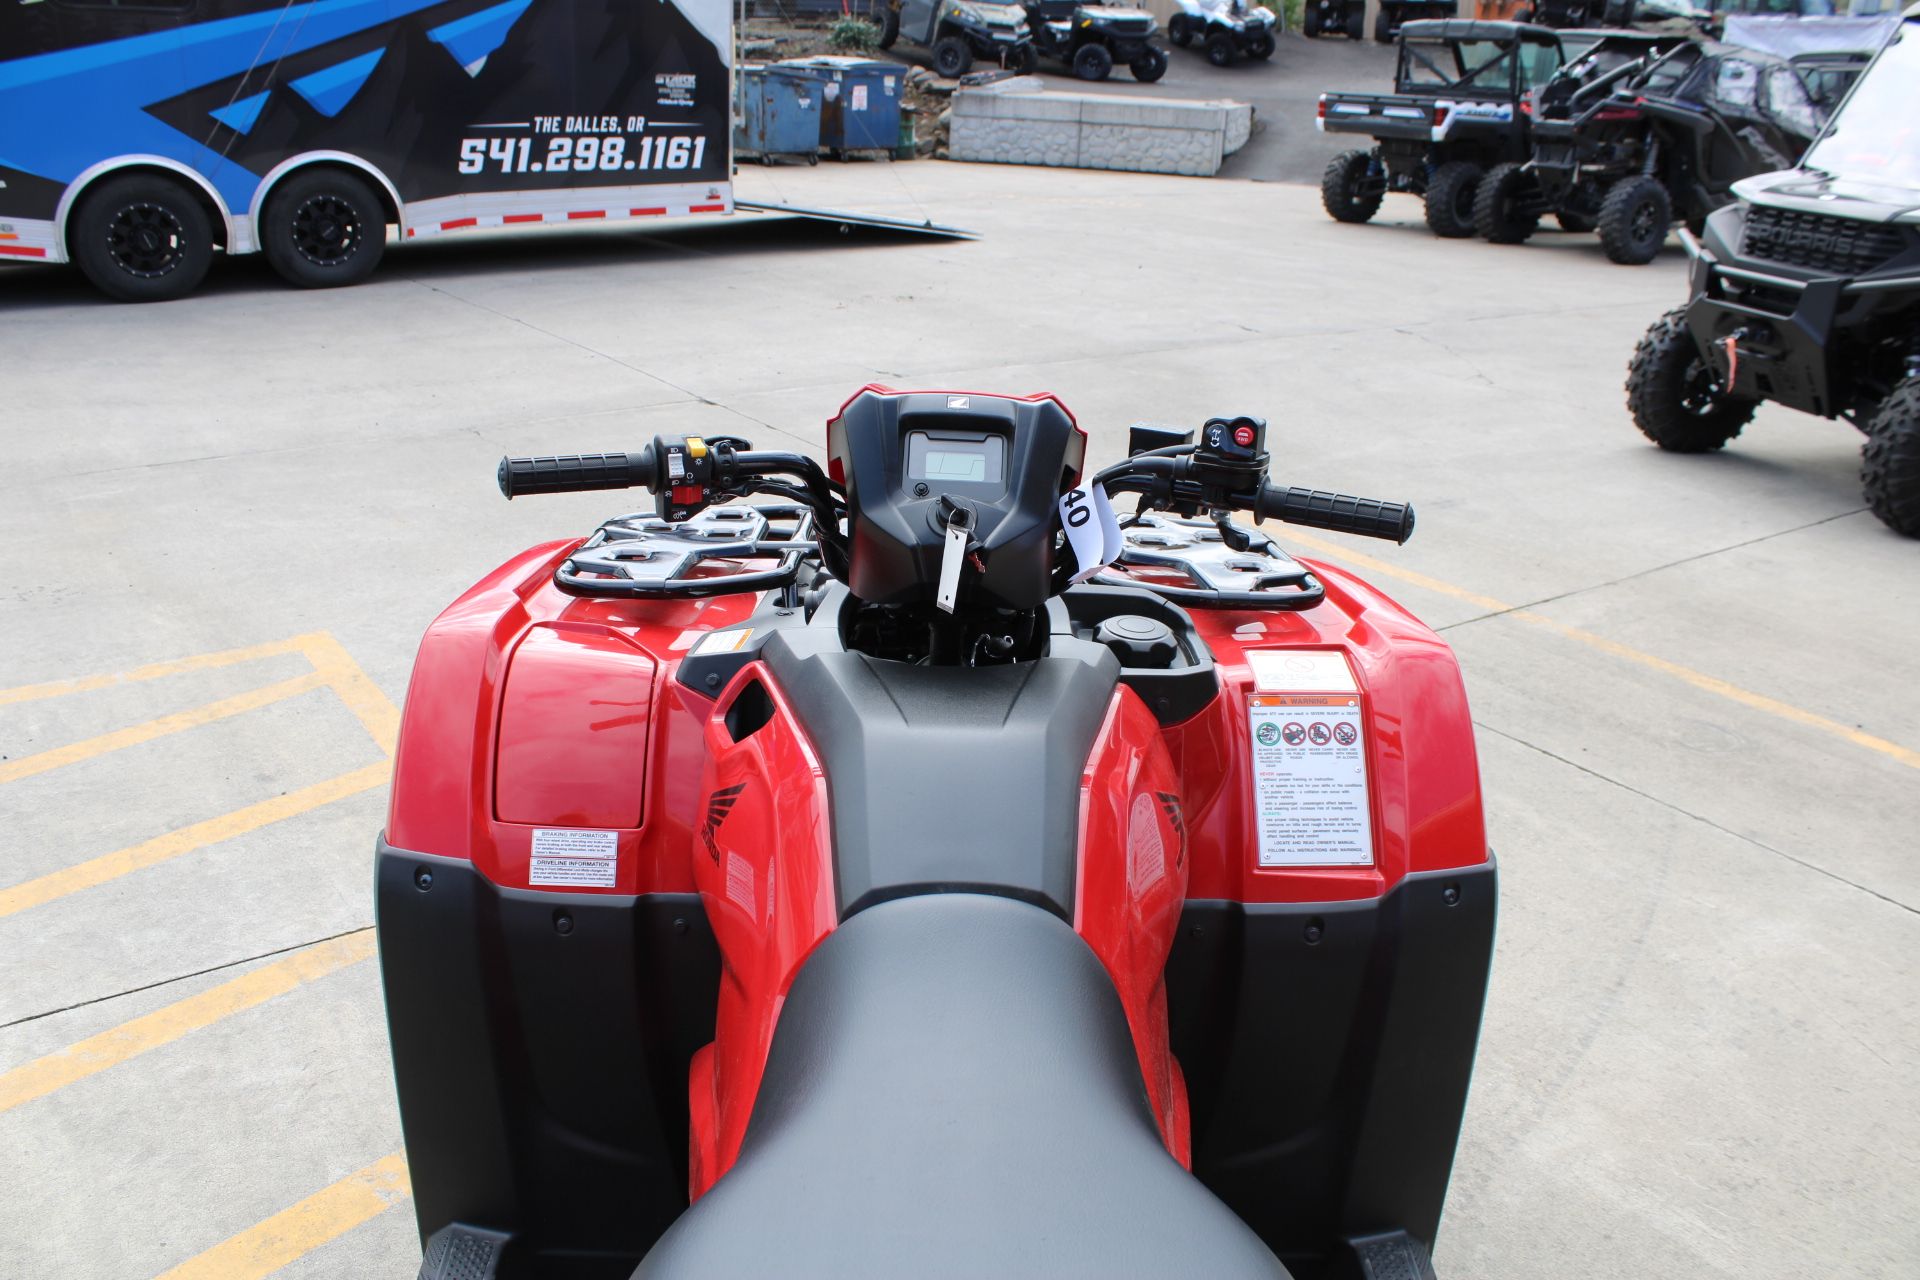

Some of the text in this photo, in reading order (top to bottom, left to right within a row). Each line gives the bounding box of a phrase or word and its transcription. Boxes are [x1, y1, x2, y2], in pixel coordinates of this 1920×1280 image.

[533, 116, 646, 135] THE DALLES, OR
[458, 136, 706, 174] 541.298.1161
[1749, 224, 1854, 254] POLARIS
[1062, 489, 1091, 528] 40
